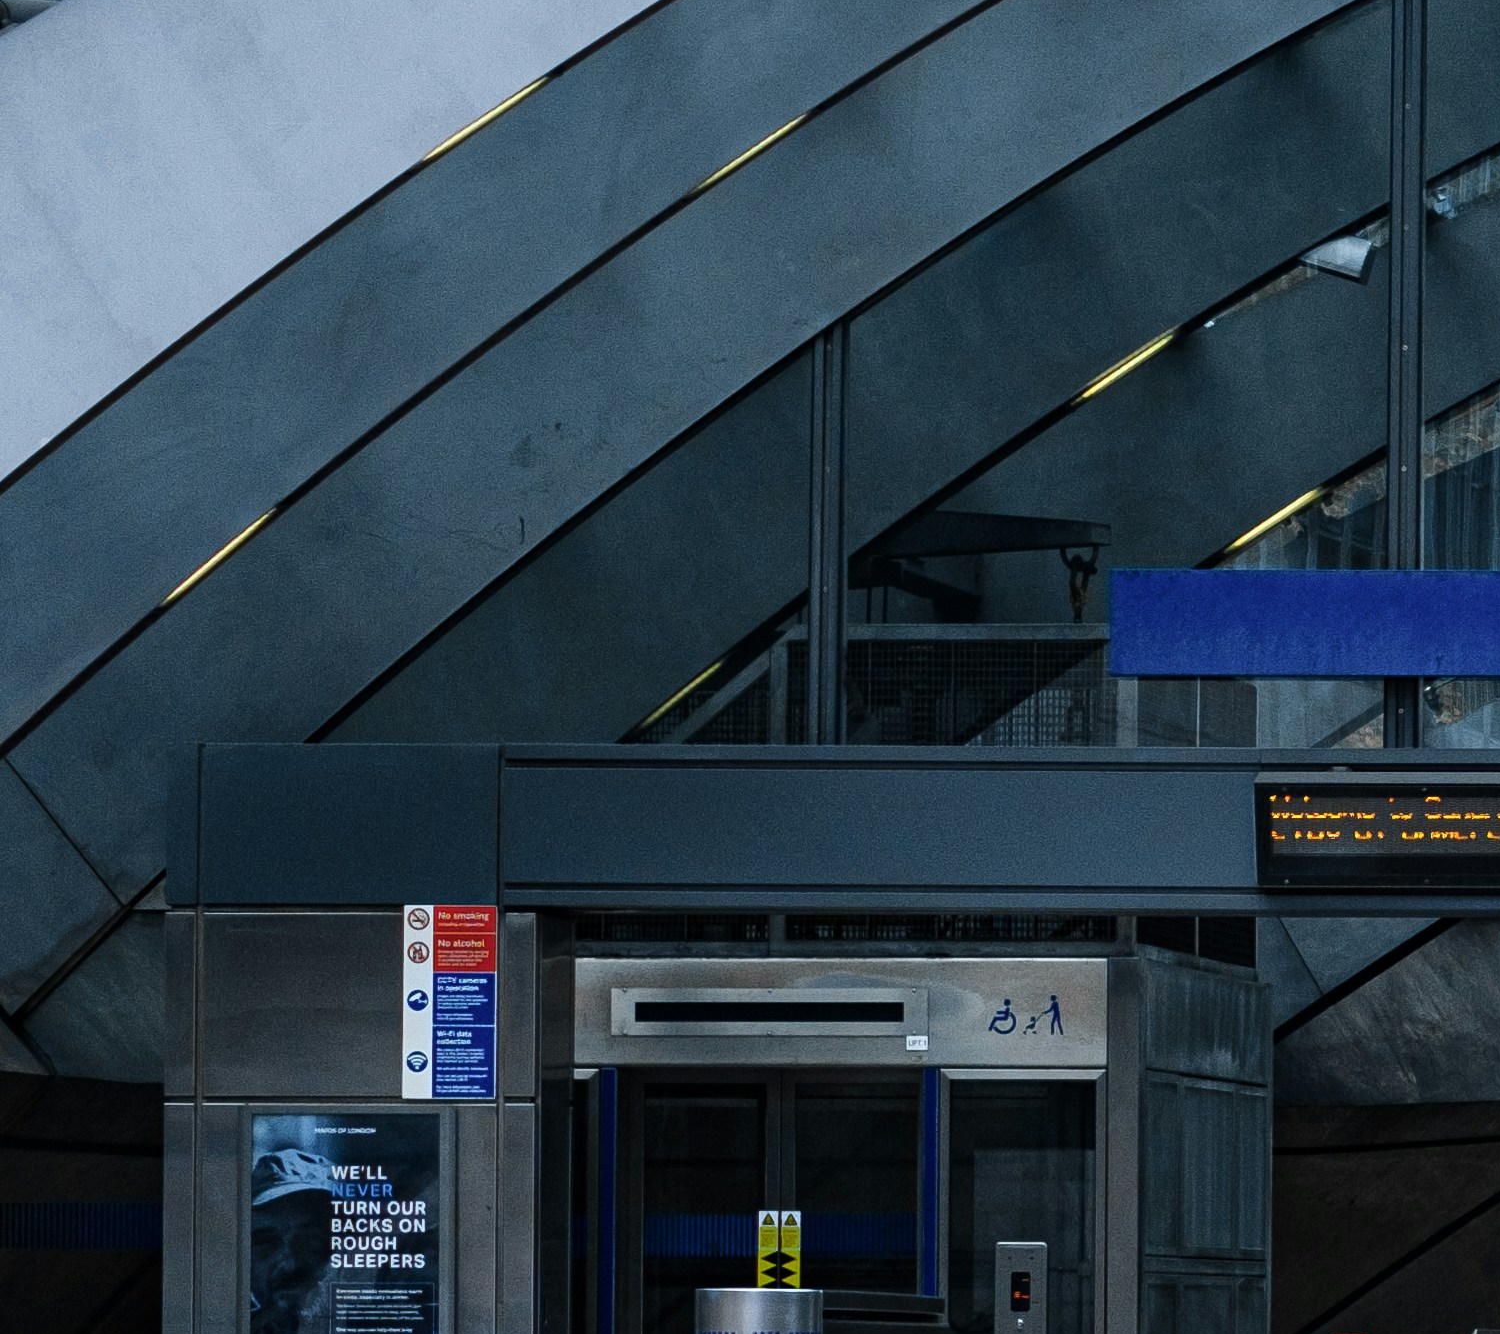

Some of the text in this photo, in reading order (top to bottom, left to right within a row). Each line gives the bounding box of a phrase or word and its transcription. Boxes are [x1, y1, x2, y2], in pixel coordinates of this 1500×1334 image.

[438, 911, 490, 921] No smoking
[438, 939, 485, 948] No alcohol
[331, 1165, 387, 1180] WE'LL
[331, 1183, 393, 1197] NEVER
[331, 1200, 426, 1215] TURN OUR
[331, 1218, 426, 1233] BACKS ON
[331, 1236, 397, 1250] ROUGH
[330, 1254, 426, 1268] SLEEPERS
